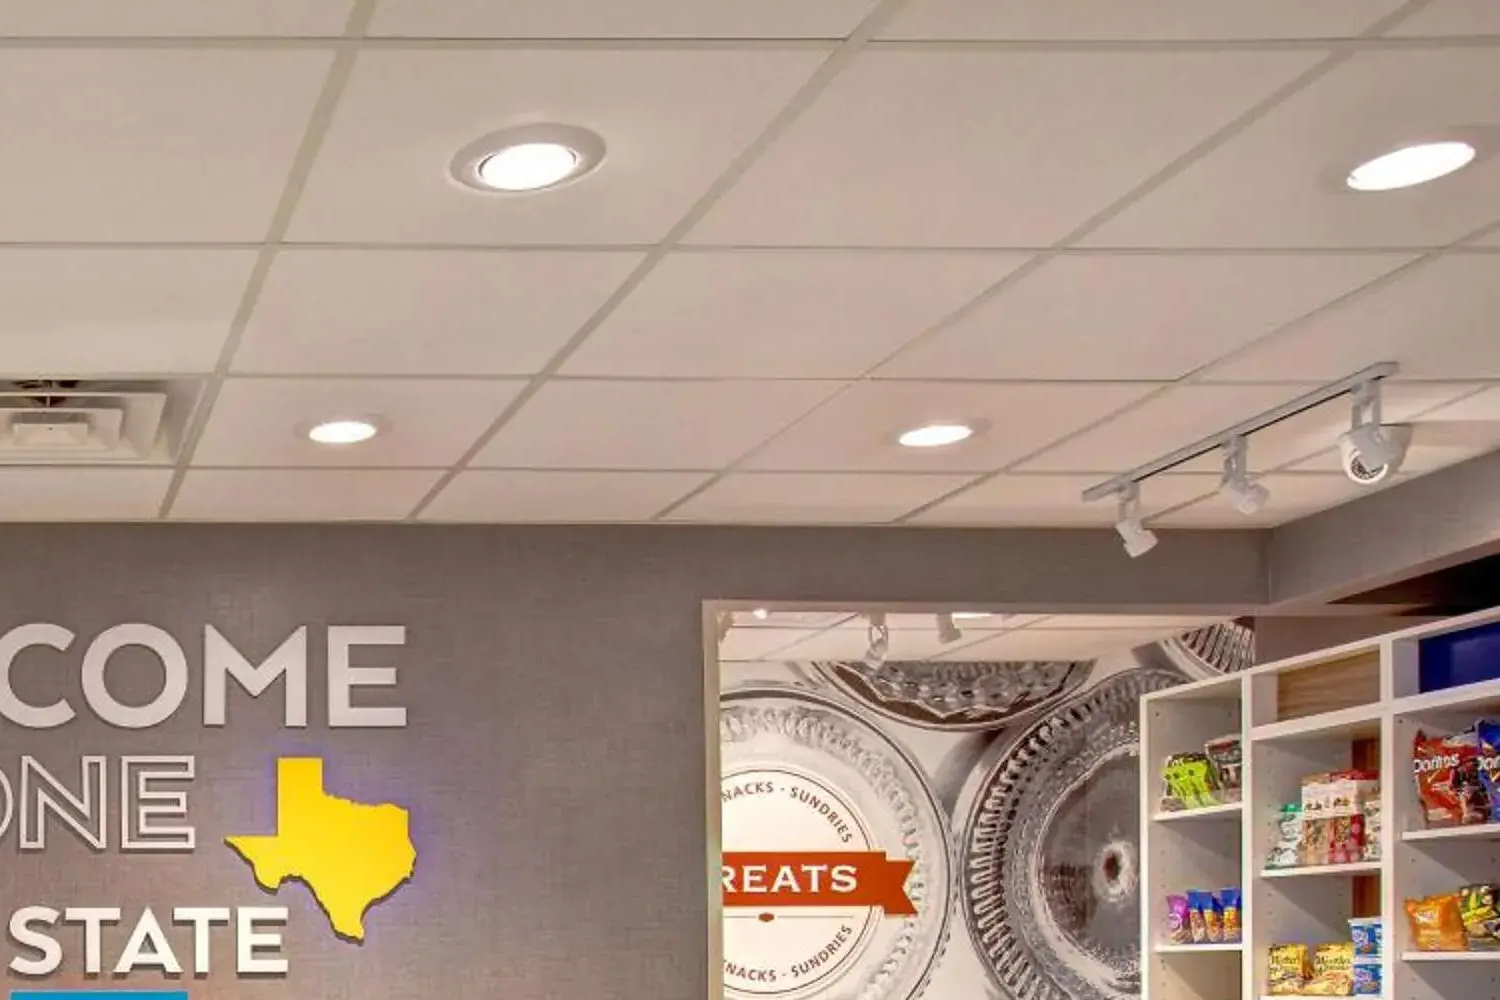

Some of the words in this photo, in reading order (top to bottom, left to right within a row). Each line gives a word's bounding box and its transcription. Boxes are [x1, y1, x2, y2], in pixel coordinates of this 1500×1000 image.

[721, 781, 774, 803] NACKS
[790, 787, 853, 843] SUNDRIES
[721, 864, 857, 894] REATS
[8, 905, 288, 975] STATE
[723, 959, 777, 983] NACKS
[790, 924, 853, 978] SUNDRIES
